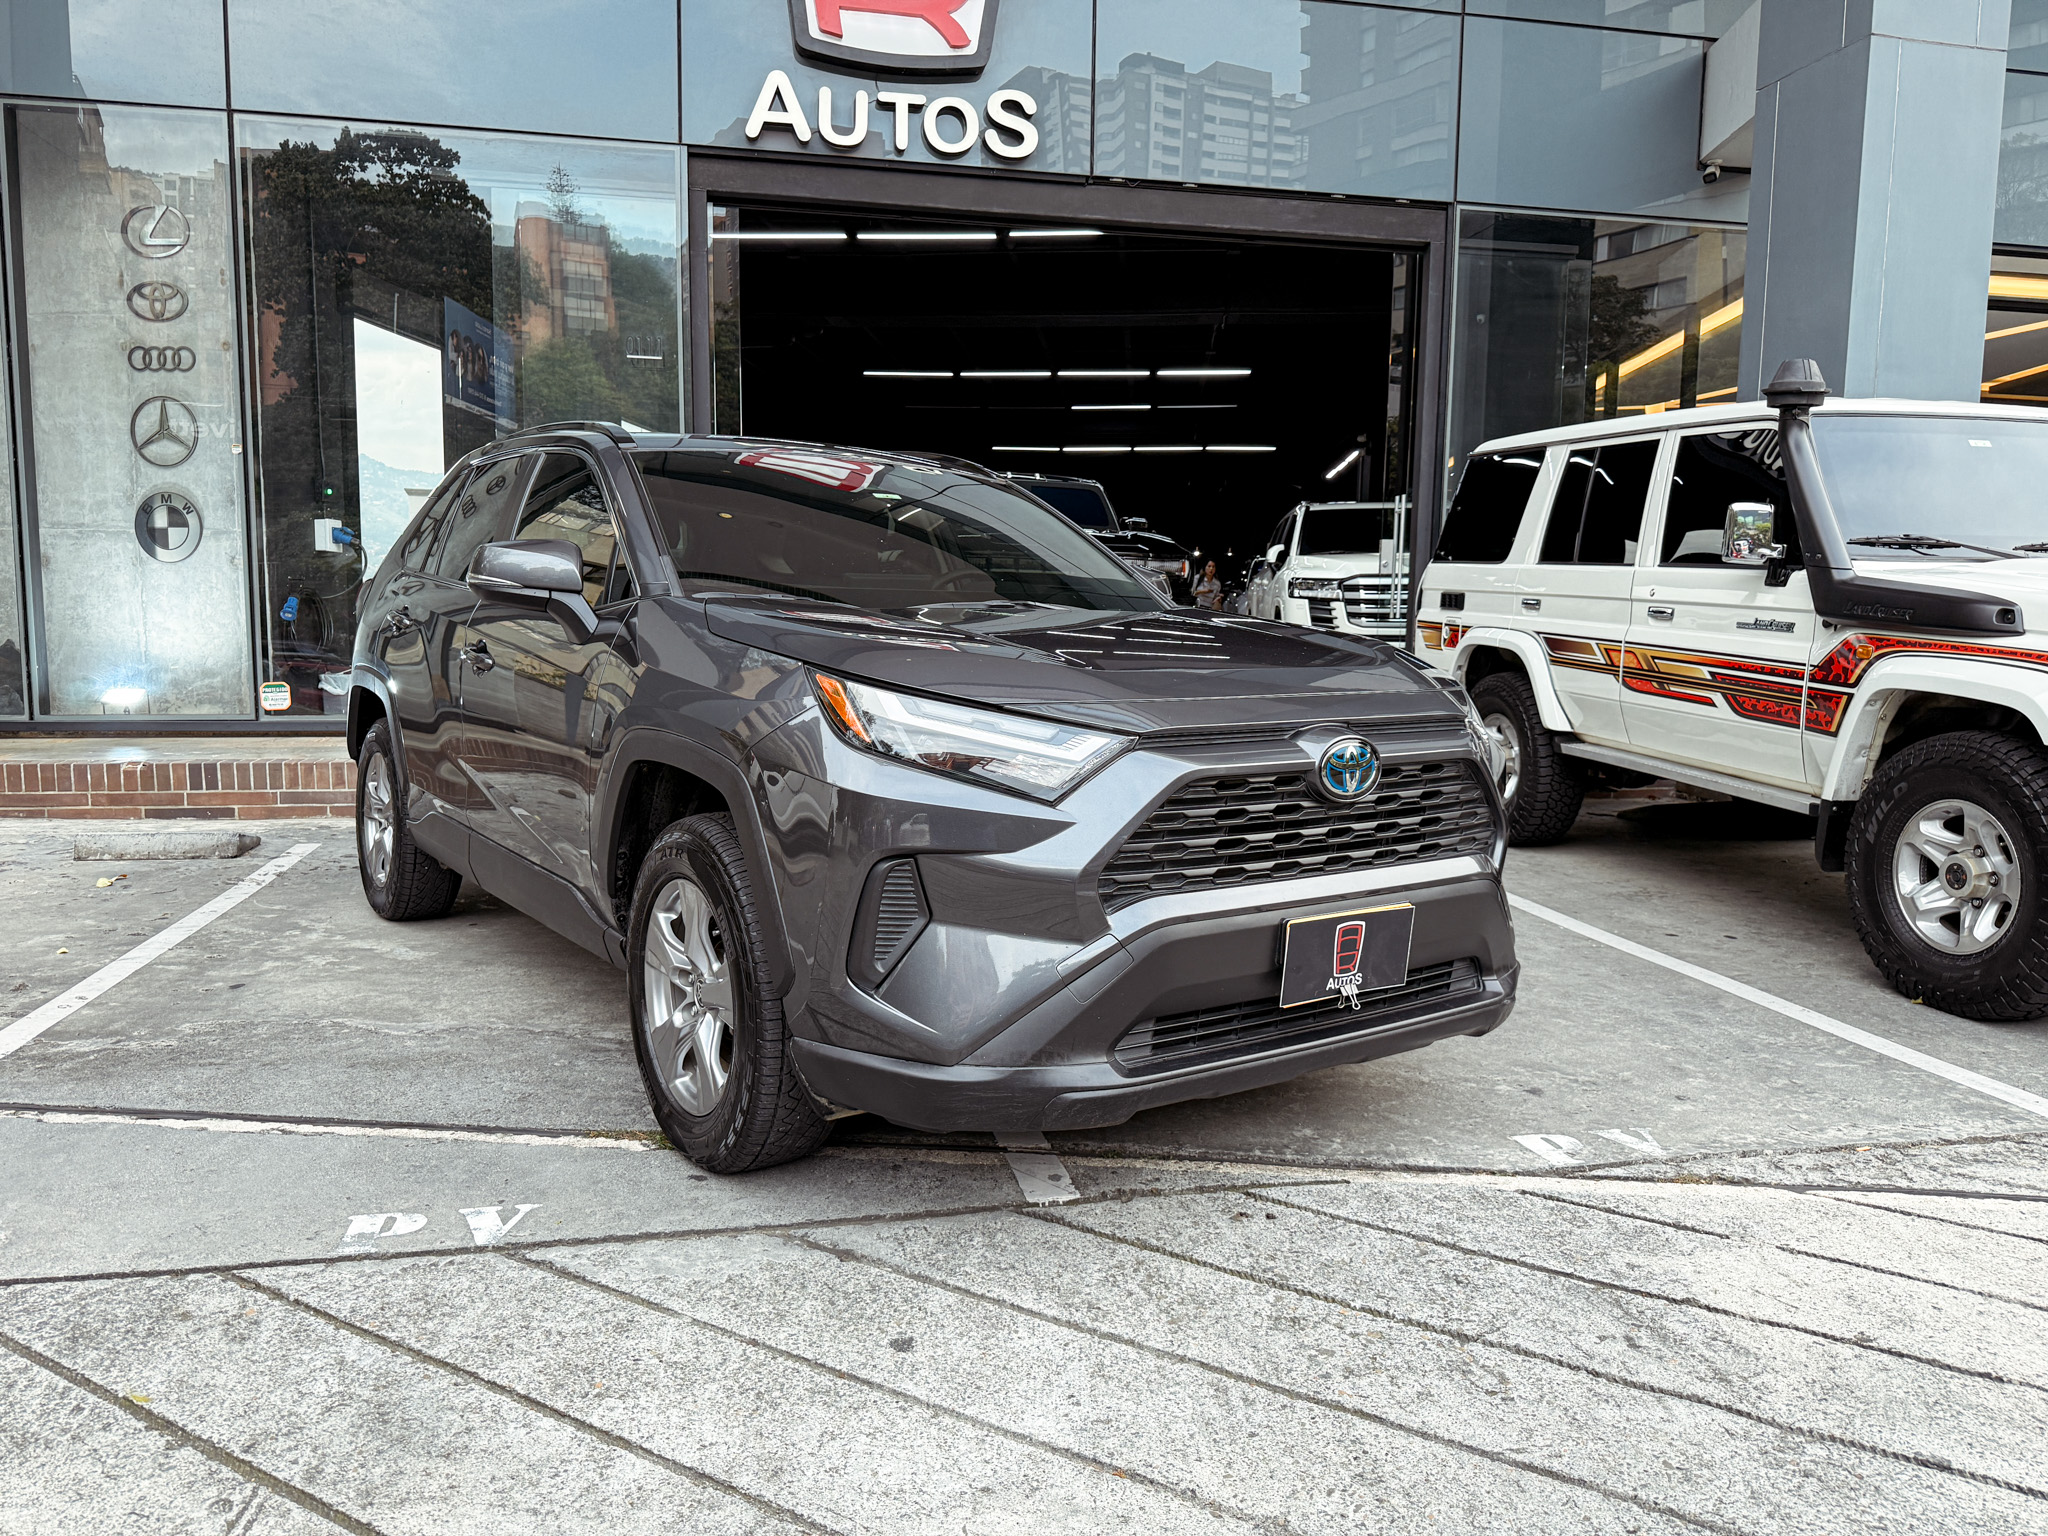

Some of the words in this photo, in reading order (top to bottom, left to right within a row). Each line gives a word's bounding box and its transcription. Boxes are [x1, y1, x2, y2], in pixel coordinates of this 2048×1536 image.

[745, 69, 1039, 158] AUTOS
[141, 493, 195, 516] BMW
[1865, 781, 1909, 845] WILD
[1325, 972, 1364, 991] AUTOS
[1507, 1133, 1586, 1166] P
[333, 1212, 428, 1254] P
[458, 1203, 543, 1246] V
